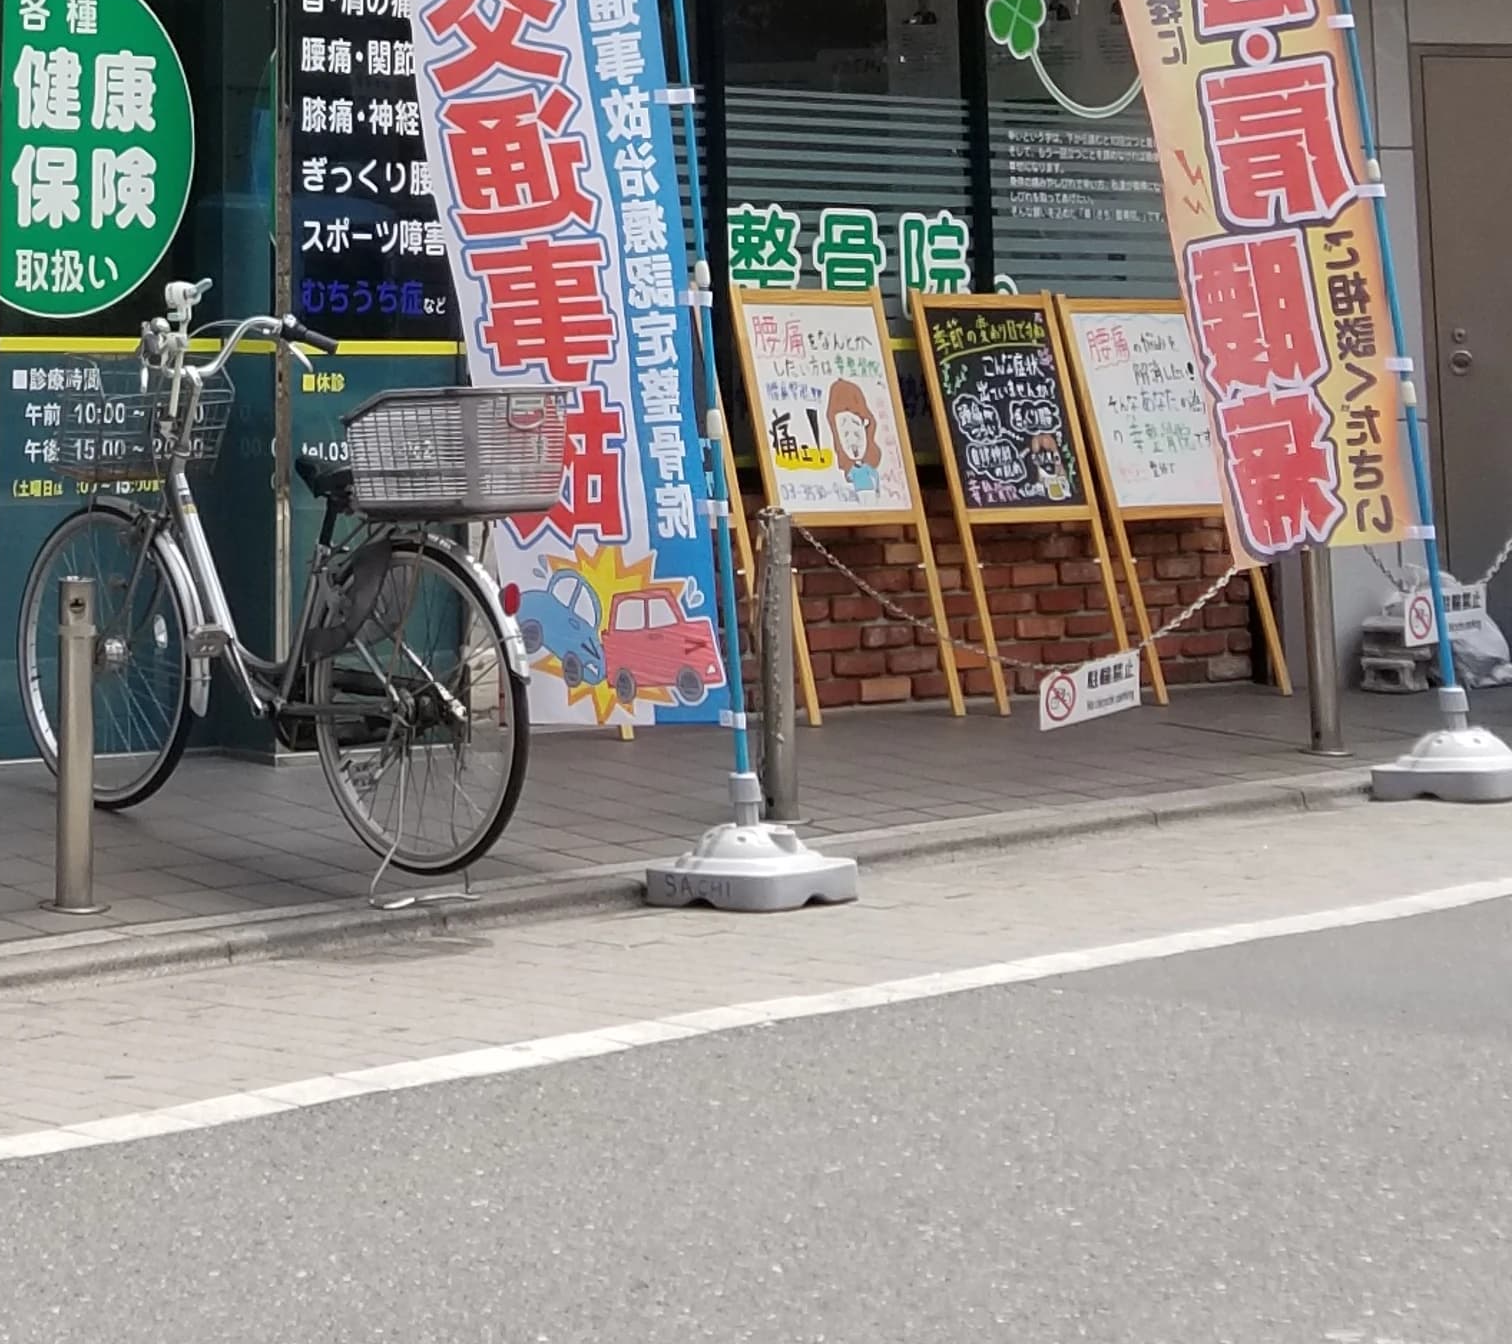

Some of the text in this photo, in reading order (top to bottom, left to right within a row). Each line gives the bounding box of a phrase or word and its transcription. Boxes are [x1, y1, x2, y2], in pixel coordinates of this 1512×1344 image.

[13, 47, 158, 133] 健康
[12, 146, 157, 229] 保険
[15, 248, 118, 294] 取扱い
